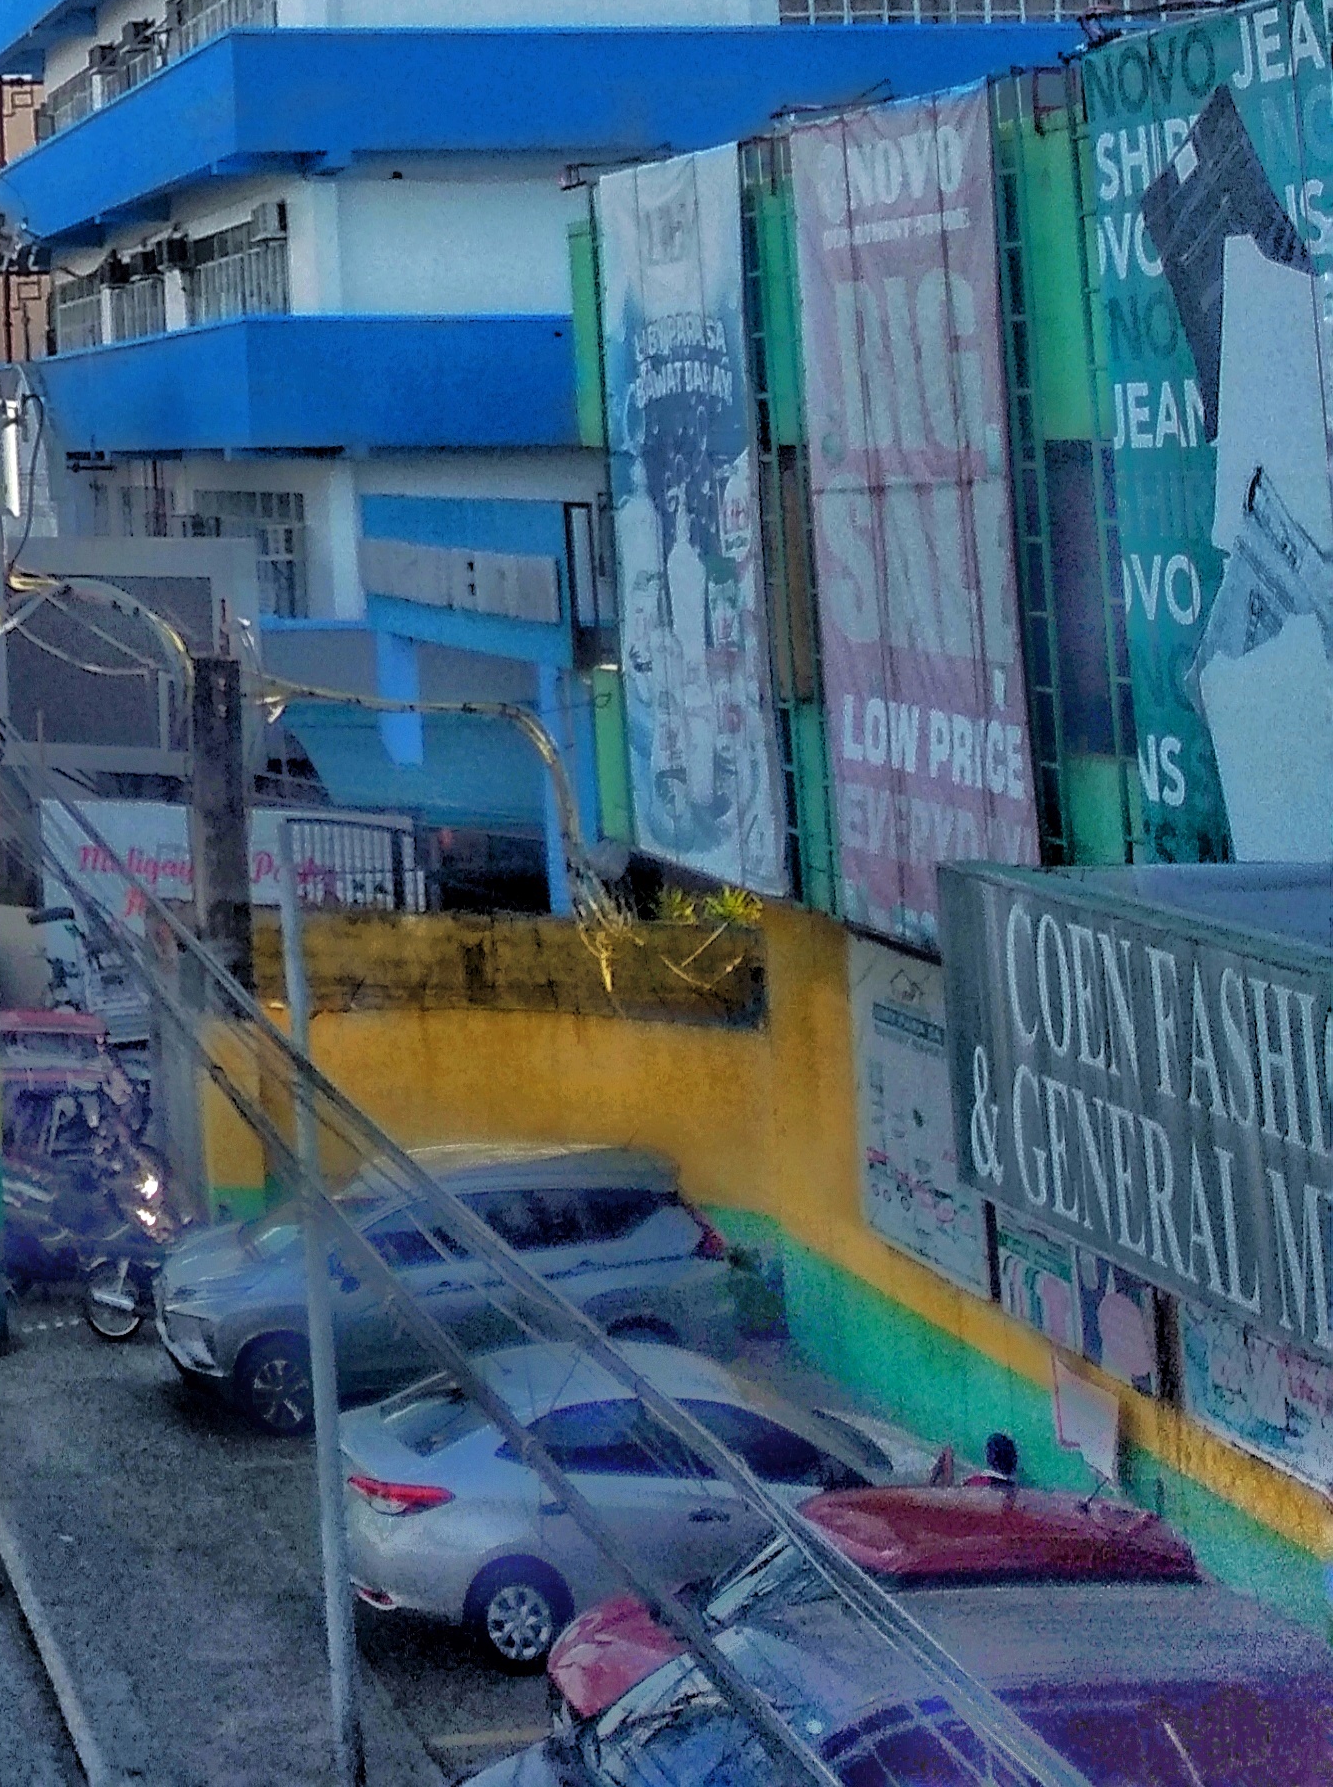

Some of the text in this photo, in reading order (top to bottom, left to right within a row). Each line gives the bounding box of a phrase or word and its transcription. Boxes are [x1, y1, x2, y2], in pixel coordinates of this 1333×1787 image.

[842, 694, 1025, 801] LOW PRICE
[1006, 902, 1333, 1157] COEN FASHI
[970, 1046, 1005, 1187] &
[1012, 1063, 1262, 1313] GENERAL
